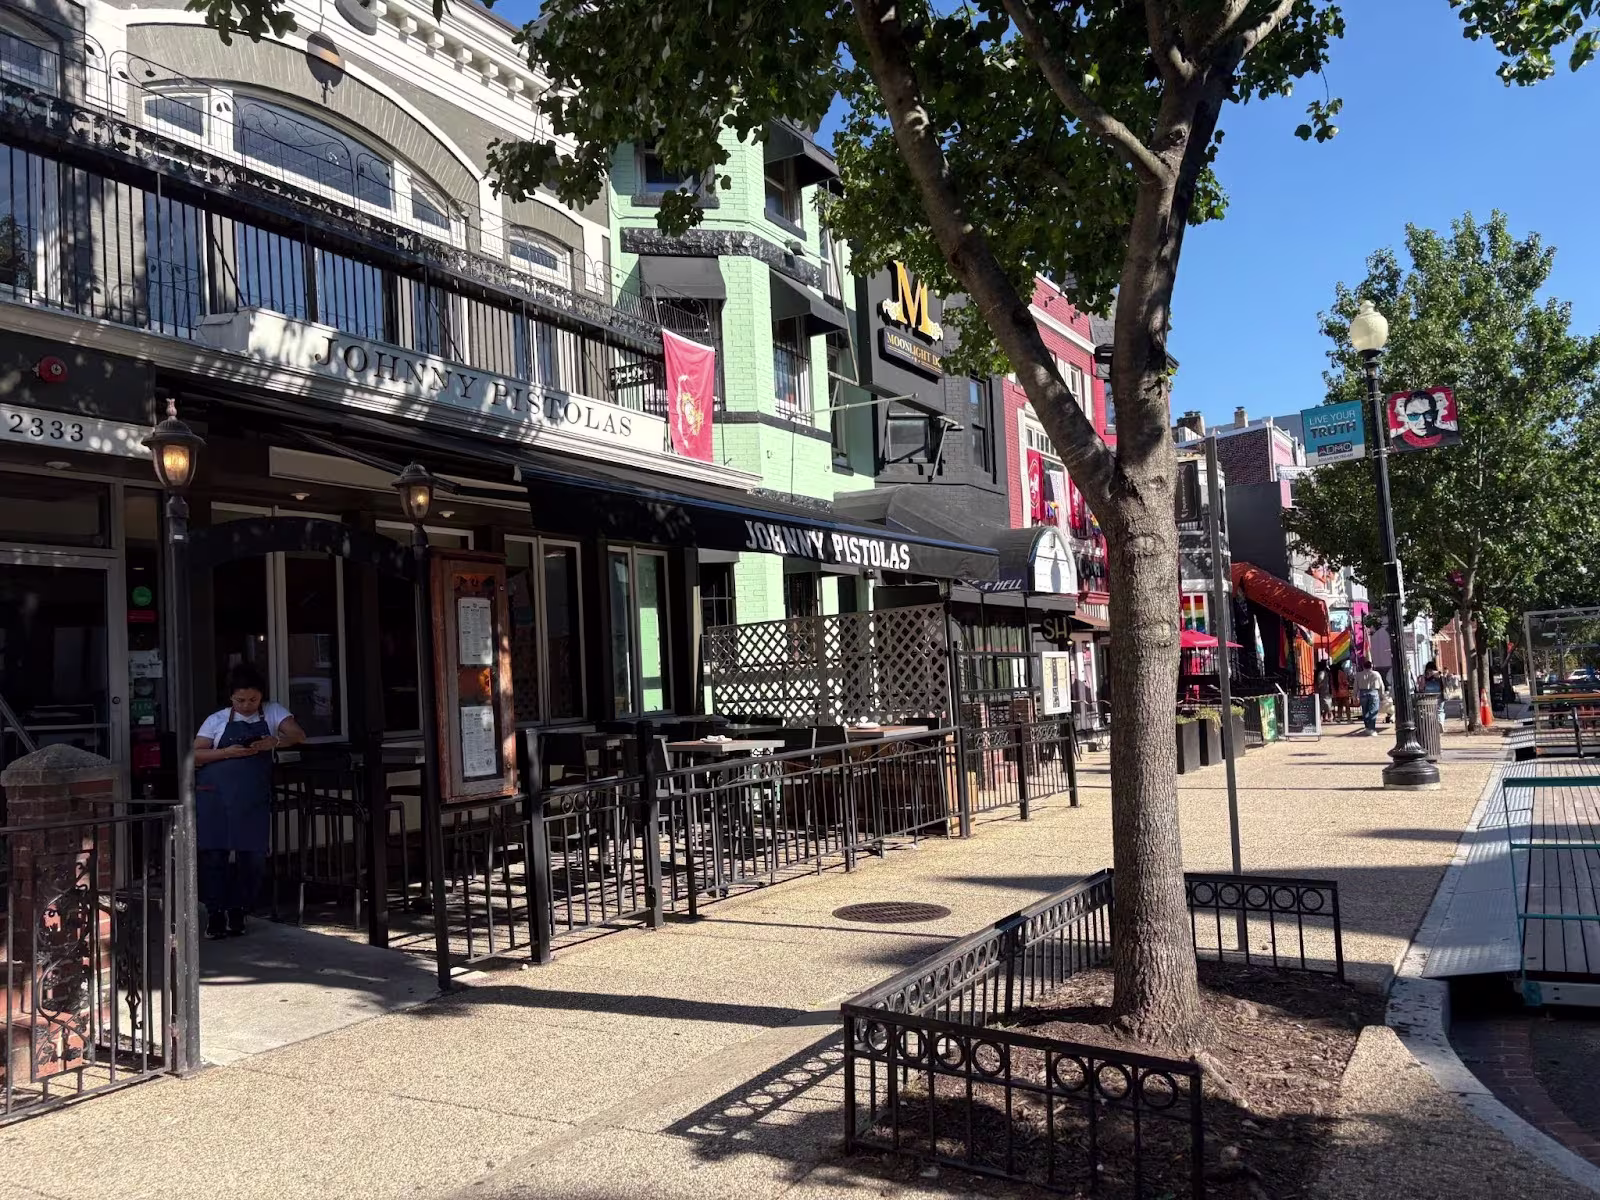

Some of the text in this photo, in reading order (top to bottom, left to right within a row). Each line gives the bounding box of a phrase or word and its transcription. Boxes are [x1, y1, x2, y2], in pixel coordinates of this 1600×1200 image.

[886, 331, 931, 362] MOONLIGHT
[314, 335, 632, 437] JOHNNY PISTOLAS
[9, 413, 84, 442] 2333
[1309, 409, 1356, 425] LIVE YOUR
[1310, 419, 1356, 438] TRUTH
[1319, 442, 1352, 455] ADMO
[744, 520, 911, 570] JOHNNY PISTOLAS
[992, 578, 1022, 591] HELL
[1043, 616, 1068, 640] SH
